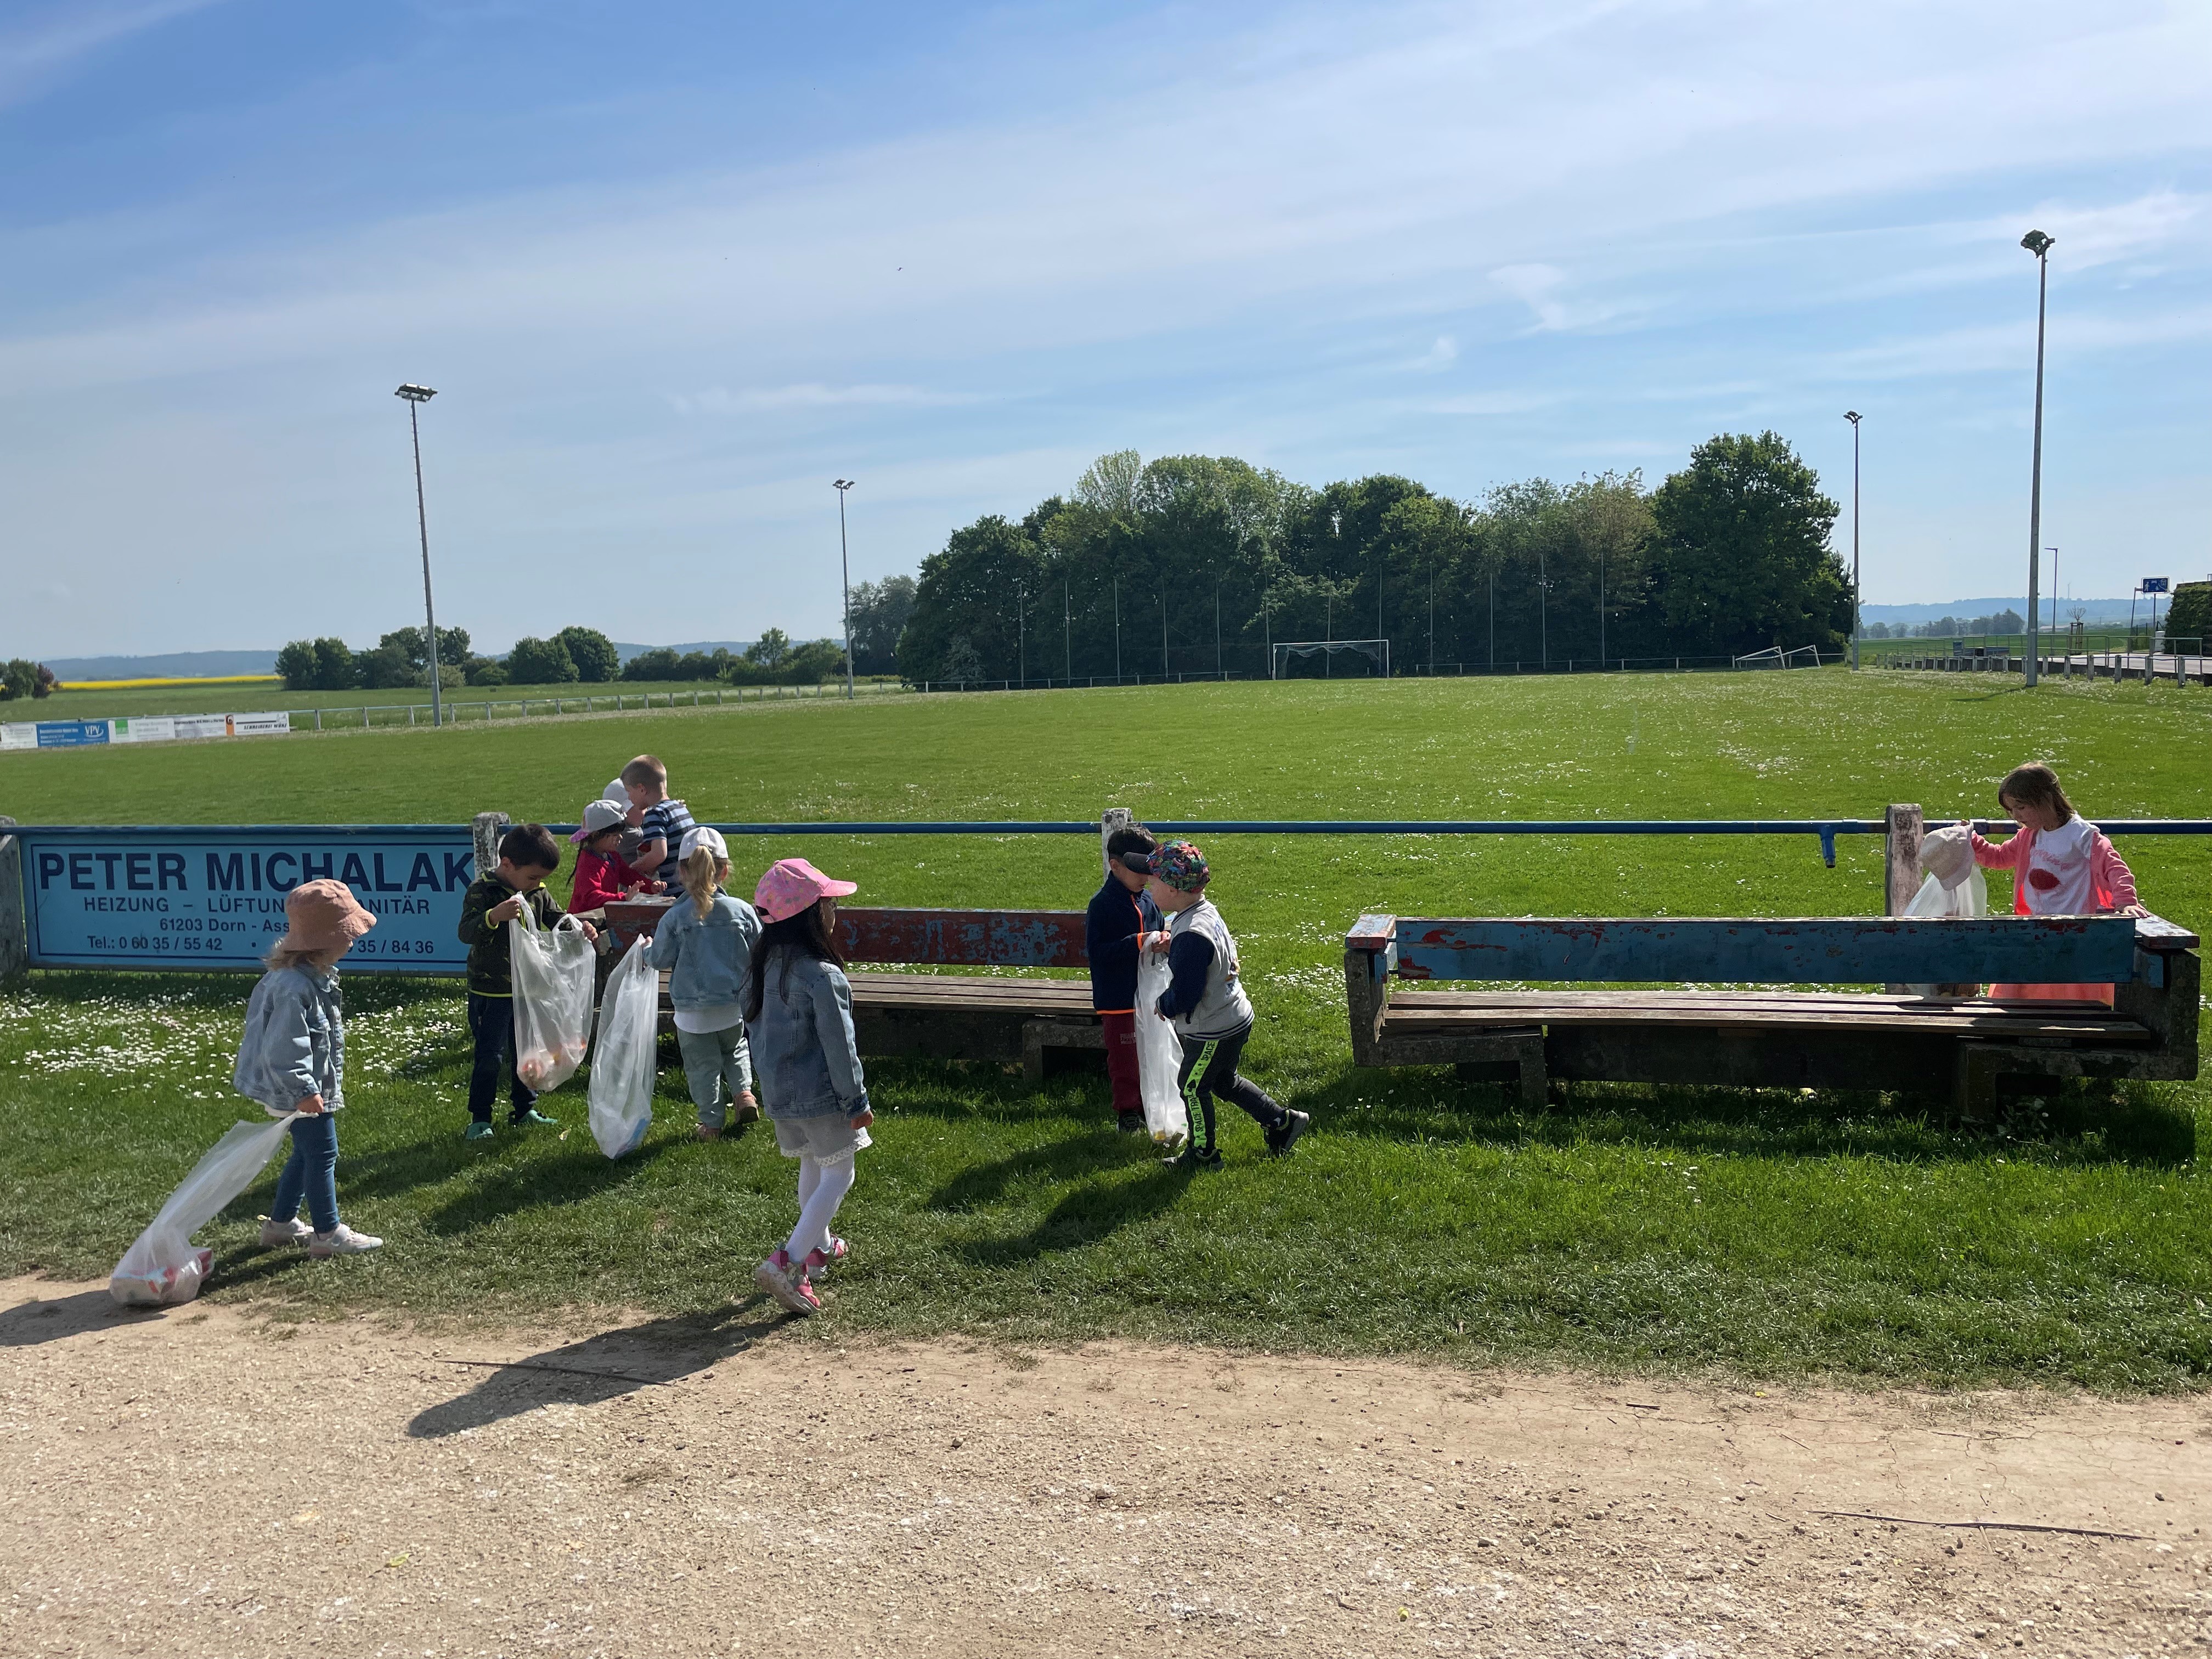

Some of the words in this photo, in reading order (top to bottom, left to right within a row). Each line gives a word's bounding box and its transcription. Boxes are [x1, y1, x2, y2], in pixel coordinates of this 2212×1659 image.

[85, 725, 100, 736] VPV
[40, 853, 188, 890] PETER
[206, 852, 474, 892] MICHALAK
[84, 896, 169, 912] HEIZUNG
[208, 894, 285, 913] LÜFTUN
[358, 895, 430, 914] NITÄR
[160, 918, 202, 931] 61203
[208, 918, 246, 932] Dorn
[262, 919, 290, 932] Ass
[87, 935, 115, 949] Tel.:
[119, 936, 127, 949] 0
[132, 936, 148, 950] 60
[153, 937, 170, 950] 35
[184, 938, 201, 950] 55
[205, 938, 222, 951] 42
[358, 940, 376, 953] 35
[392, 940, 410, 953] 84
[415, 940, 434, 954] 36
[1193, 1112, 1204, 1132] SPACE
